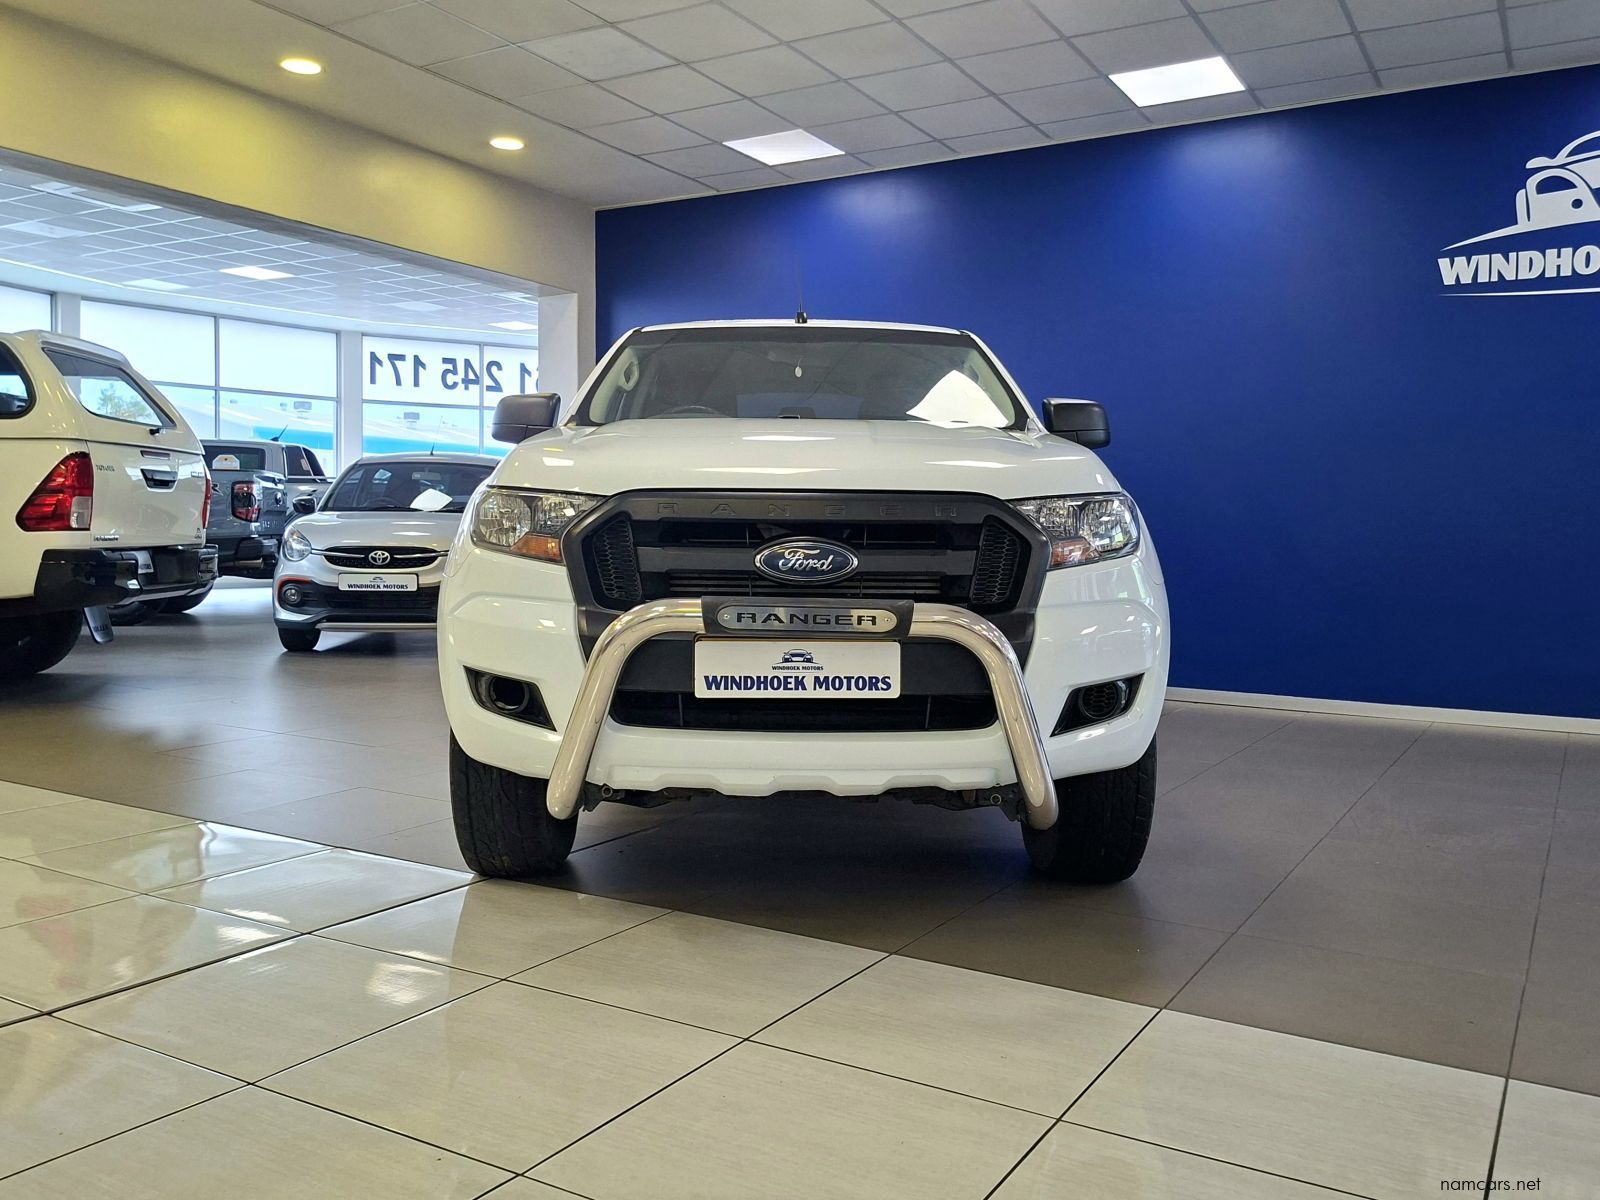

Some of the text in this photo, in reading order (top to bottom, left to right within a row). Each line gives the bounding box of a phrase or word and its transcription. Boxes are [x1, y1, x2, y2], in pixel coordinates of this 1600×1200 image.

[656, 502, 958, 517] RANGER
[778, 548, 835, 571] Ford
[736, 612, 877, 626] RANGER
[704, 675, 892, 691] WINDHOEK MOTORS
